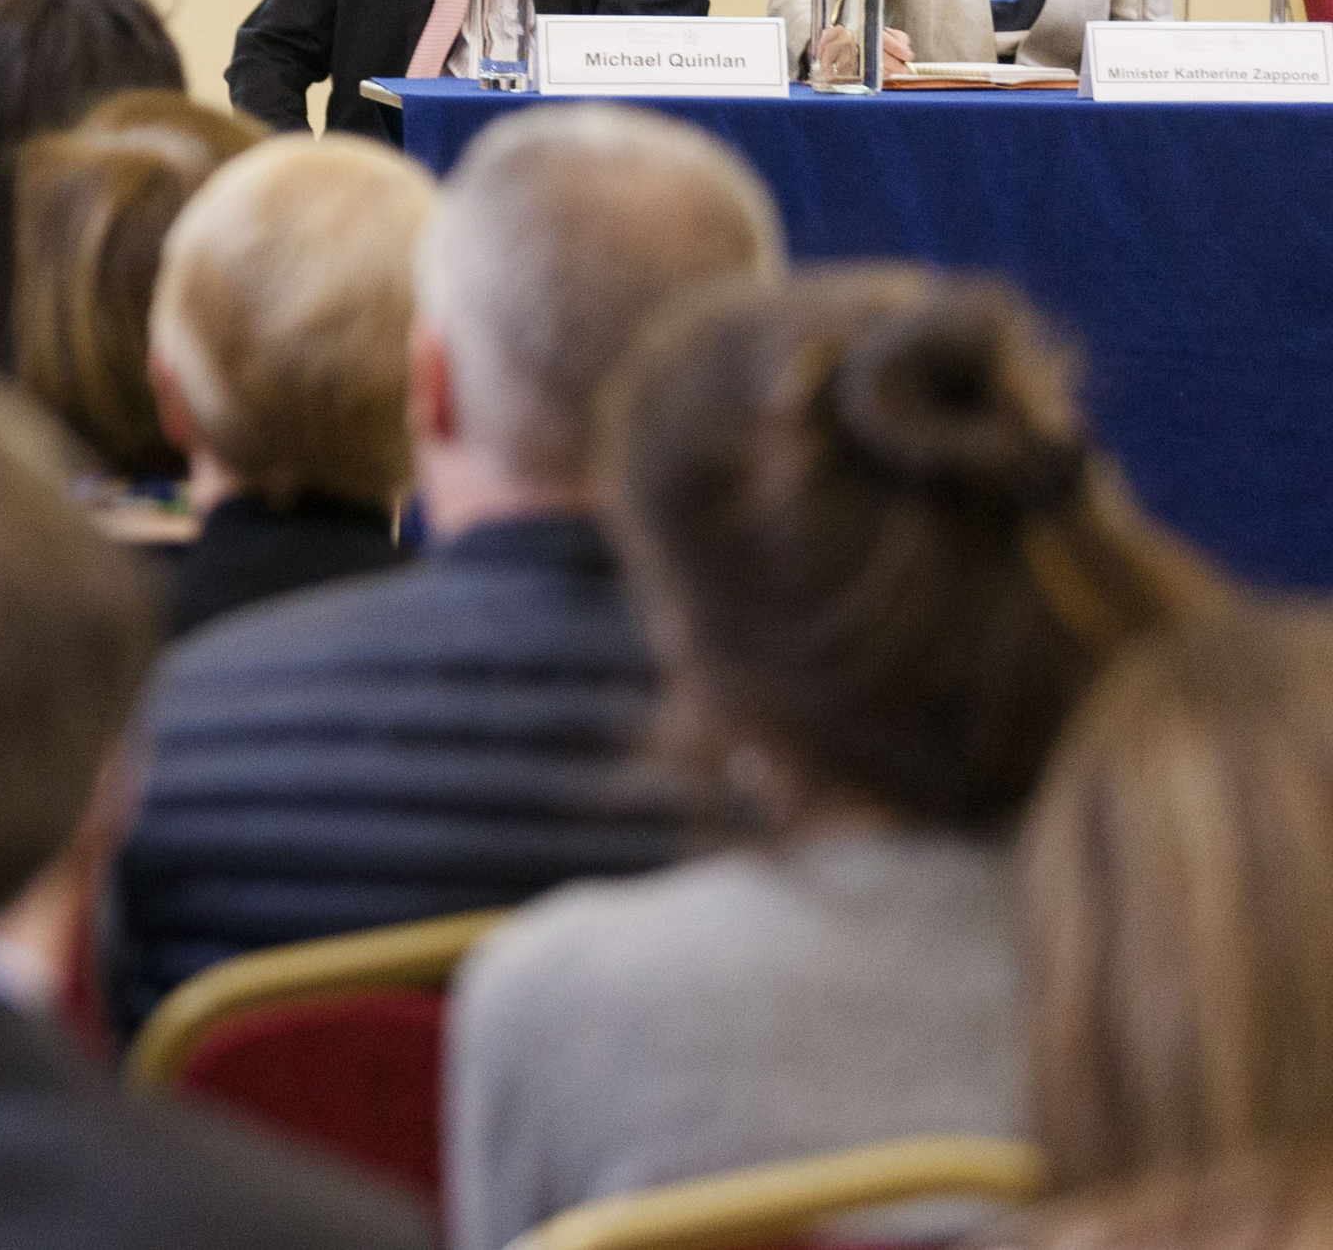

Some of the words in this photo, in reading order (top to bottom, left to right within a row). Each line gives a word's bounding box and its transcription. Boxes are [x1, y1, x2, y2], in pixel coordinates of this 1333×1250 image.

[585, 52, 662, 68] Michael
[667, 52, 746, 69] Quinlan
[1107, 67, 1169, 80] Minister
[1174, 67, 1248, 81] Katherine
[1252, 68, 1320, 84] Zappone
